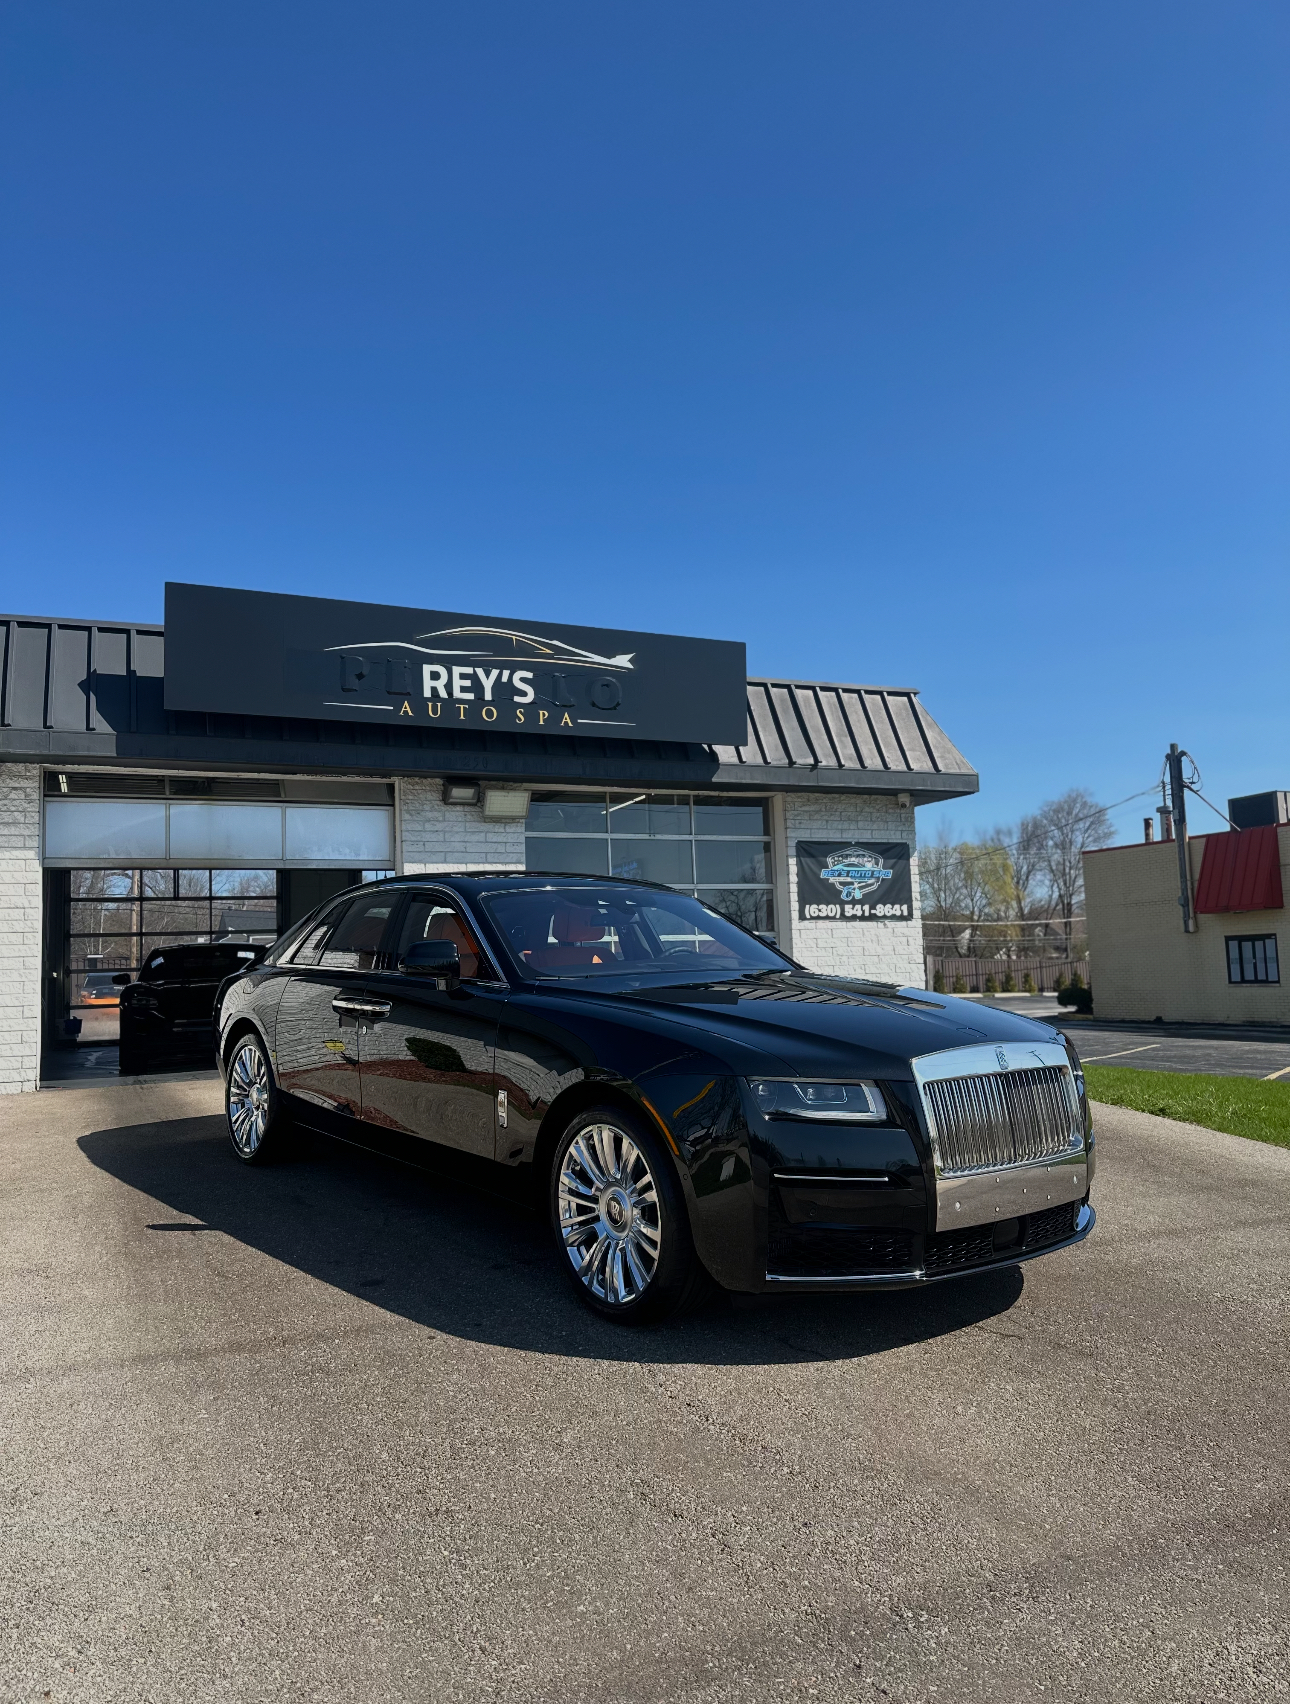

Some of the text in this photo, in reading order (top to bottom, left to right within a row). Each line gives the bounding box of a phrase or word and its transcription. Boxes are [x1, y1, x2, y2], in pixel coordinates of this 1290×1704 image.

[422, 663, 535, 704] REY'S
[822, 869, 848, 877] REY'S
[804, 903, 908, 919] (630) 541-8641
